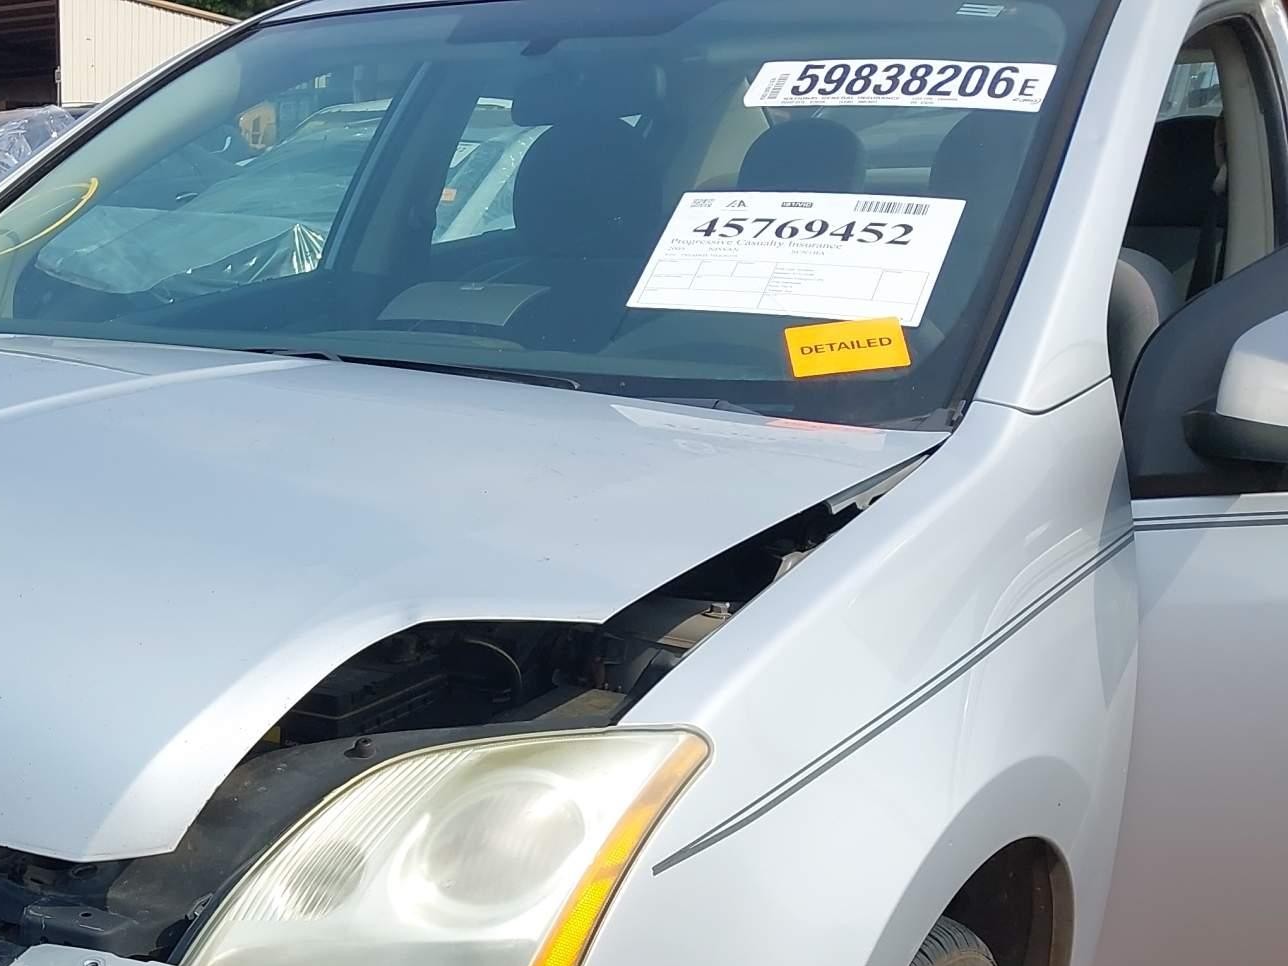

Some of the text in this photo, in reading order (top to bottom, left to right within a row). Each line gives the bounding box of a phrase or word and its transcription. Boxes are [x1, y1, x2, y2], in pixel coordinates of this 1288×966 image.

[791, 64, 1020, 99] 59838206
[1019, 78, 1040, 97] E
[670, 237, 844, 250] Progressive Casualty Insurance
[692, 217, 914, 246] 45769452
[800, 337, 892, 356] DETAILED
